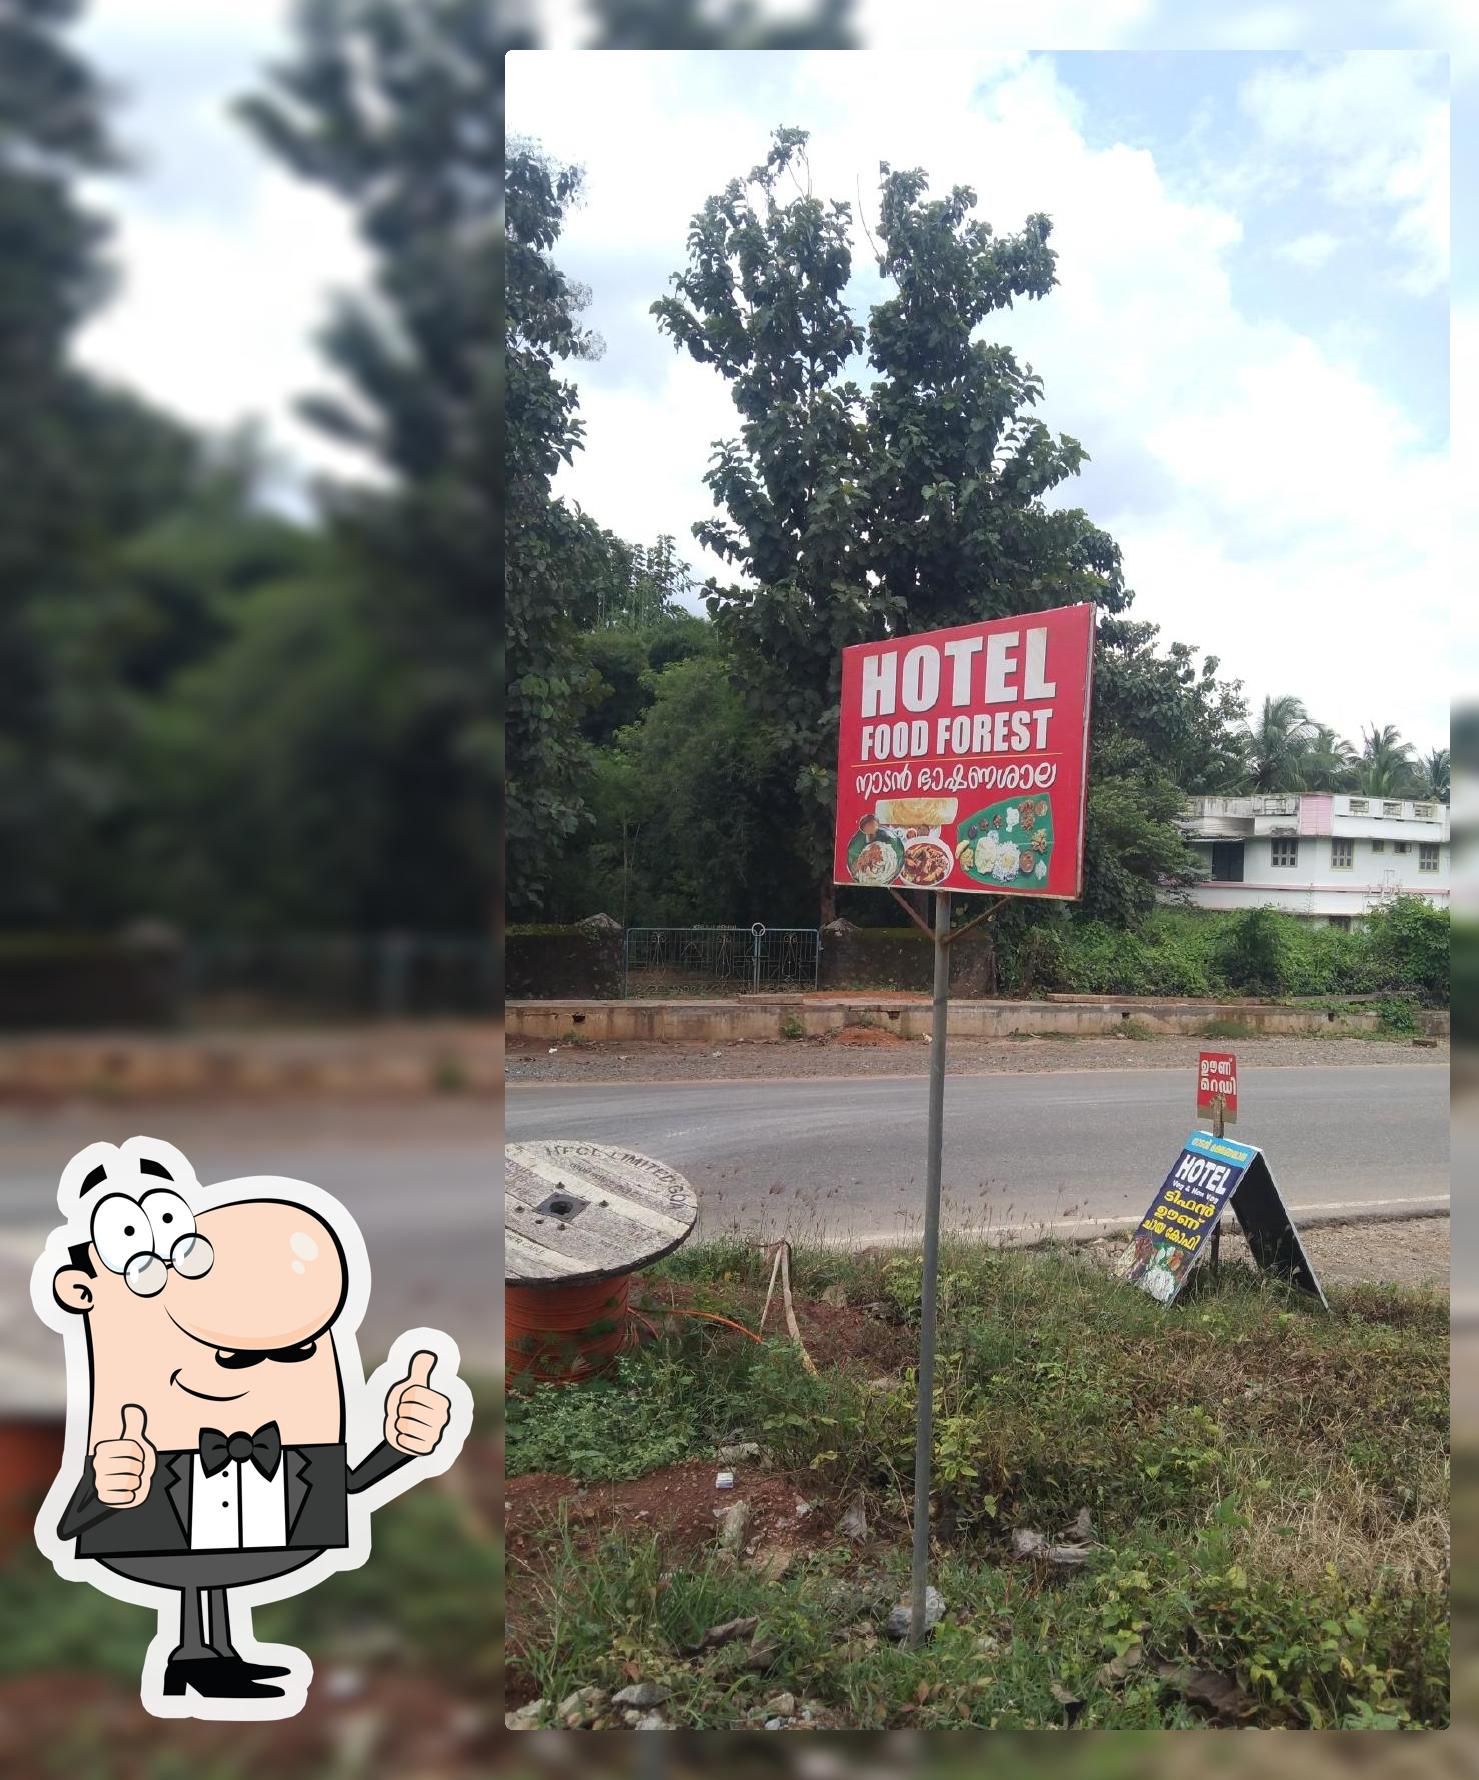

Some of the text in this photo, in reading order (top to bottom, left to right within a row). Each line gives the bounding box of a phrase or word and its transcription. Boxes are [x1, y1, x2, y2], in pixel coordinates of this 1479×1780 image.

[861, 627, 1056, 718] HOTEL
[861, 709, 1053, 760] FOOD FOREST
[856, 763, 912, 800] നാടൻ
[1175, 1154, 1231, 1195] HOTEL
